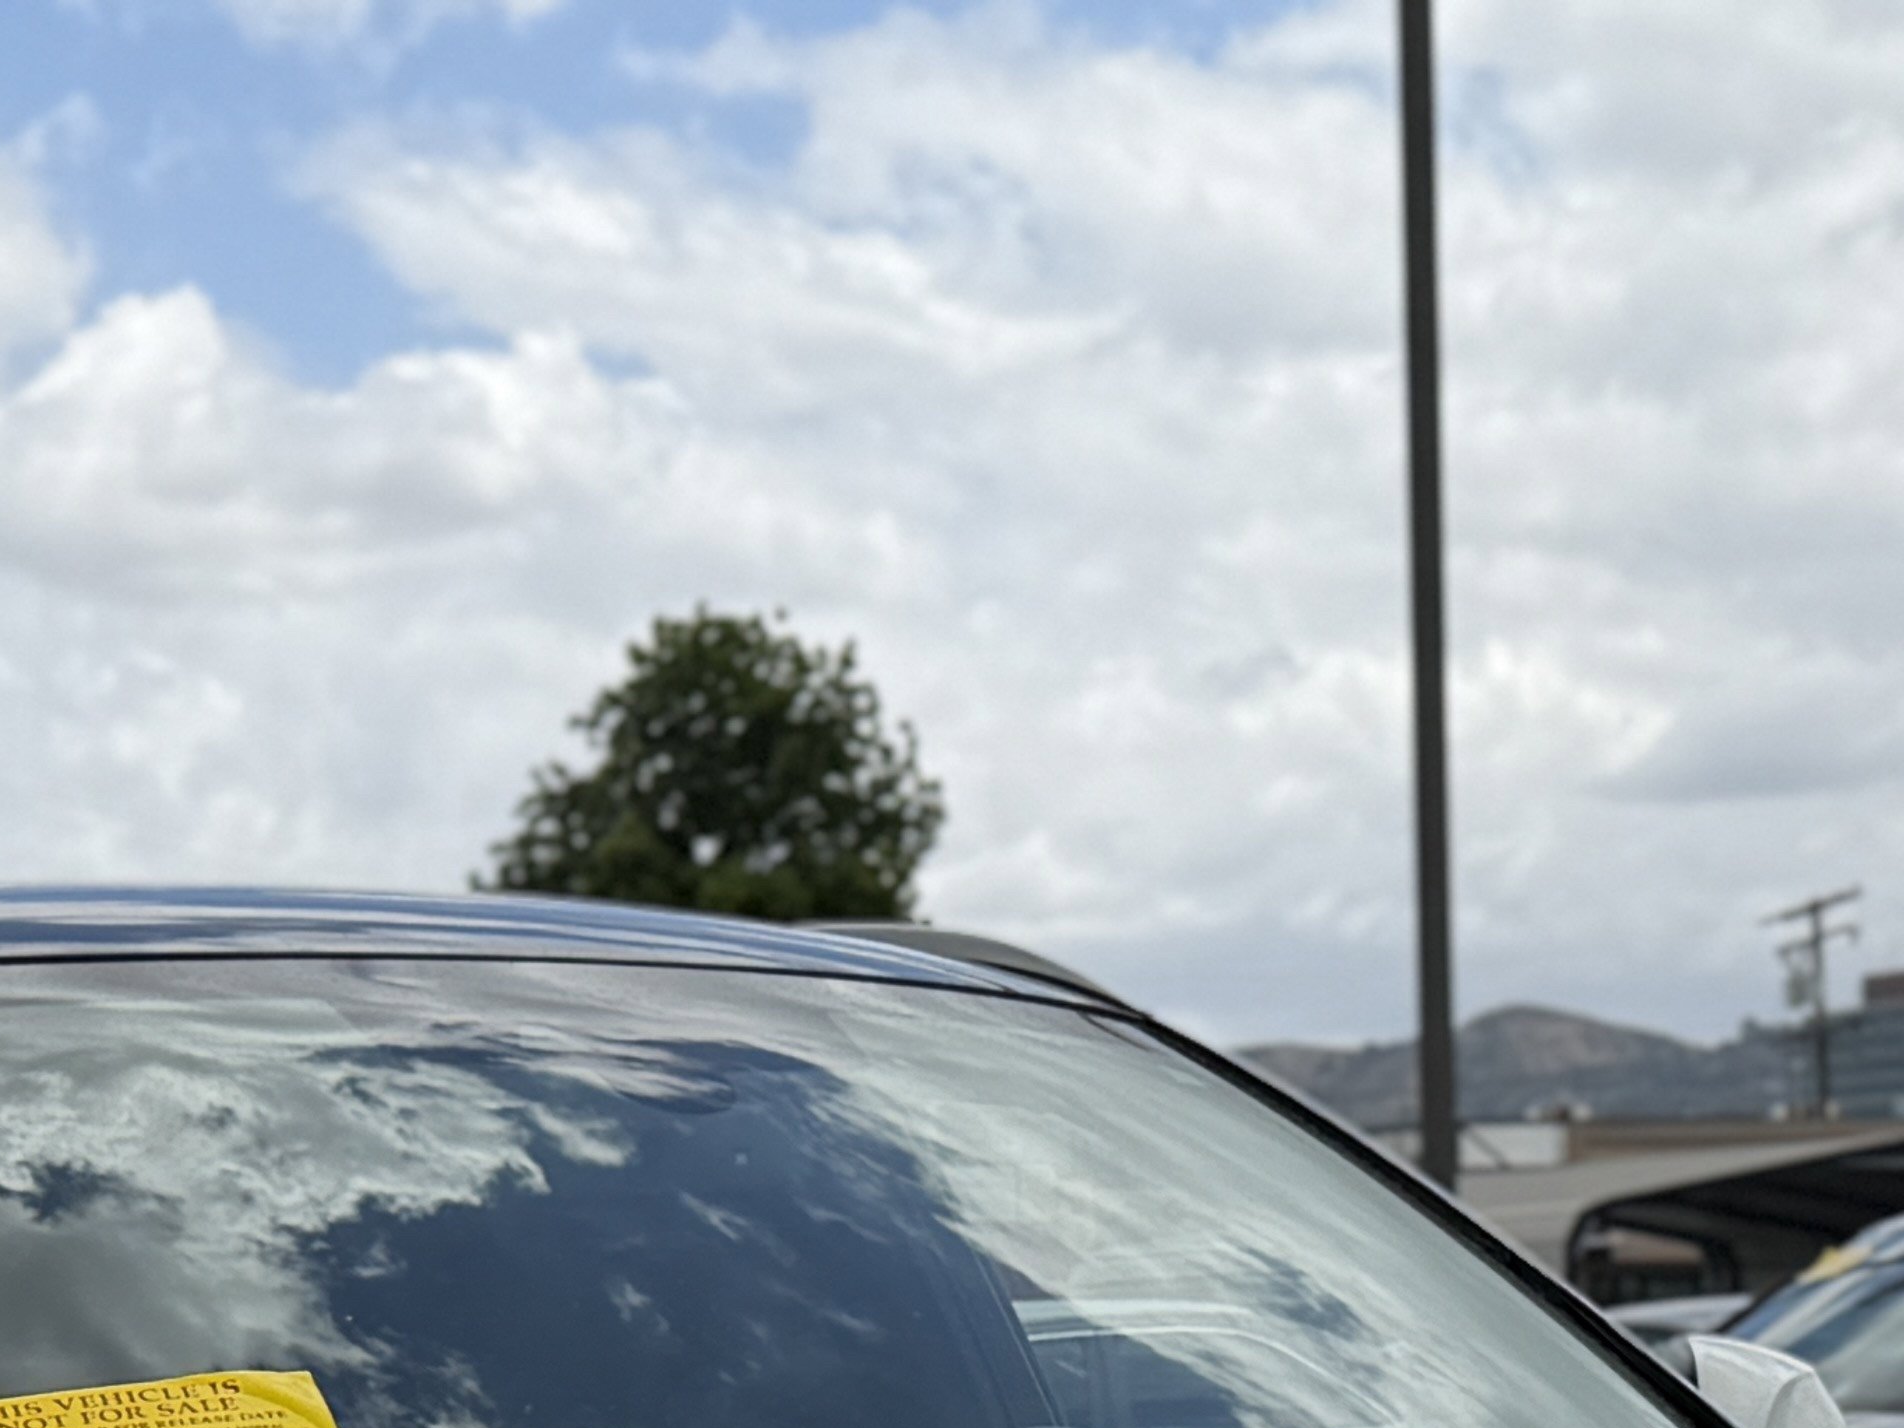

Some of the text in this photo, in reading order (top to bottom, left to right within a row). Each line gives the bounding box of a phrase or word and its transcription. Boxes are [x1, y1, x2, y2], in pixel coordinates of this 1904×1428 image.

[52, 1383, 200, 1412] VEHICLE
[208, 1378, 241, 1395] IS
[80, 1405, 147, 1425] FOR
[156, 1396, 240, 1417] SALE
[154, 1413, 235, 1428] RELEASE
[239, 1410, 287, 1422] DATE
